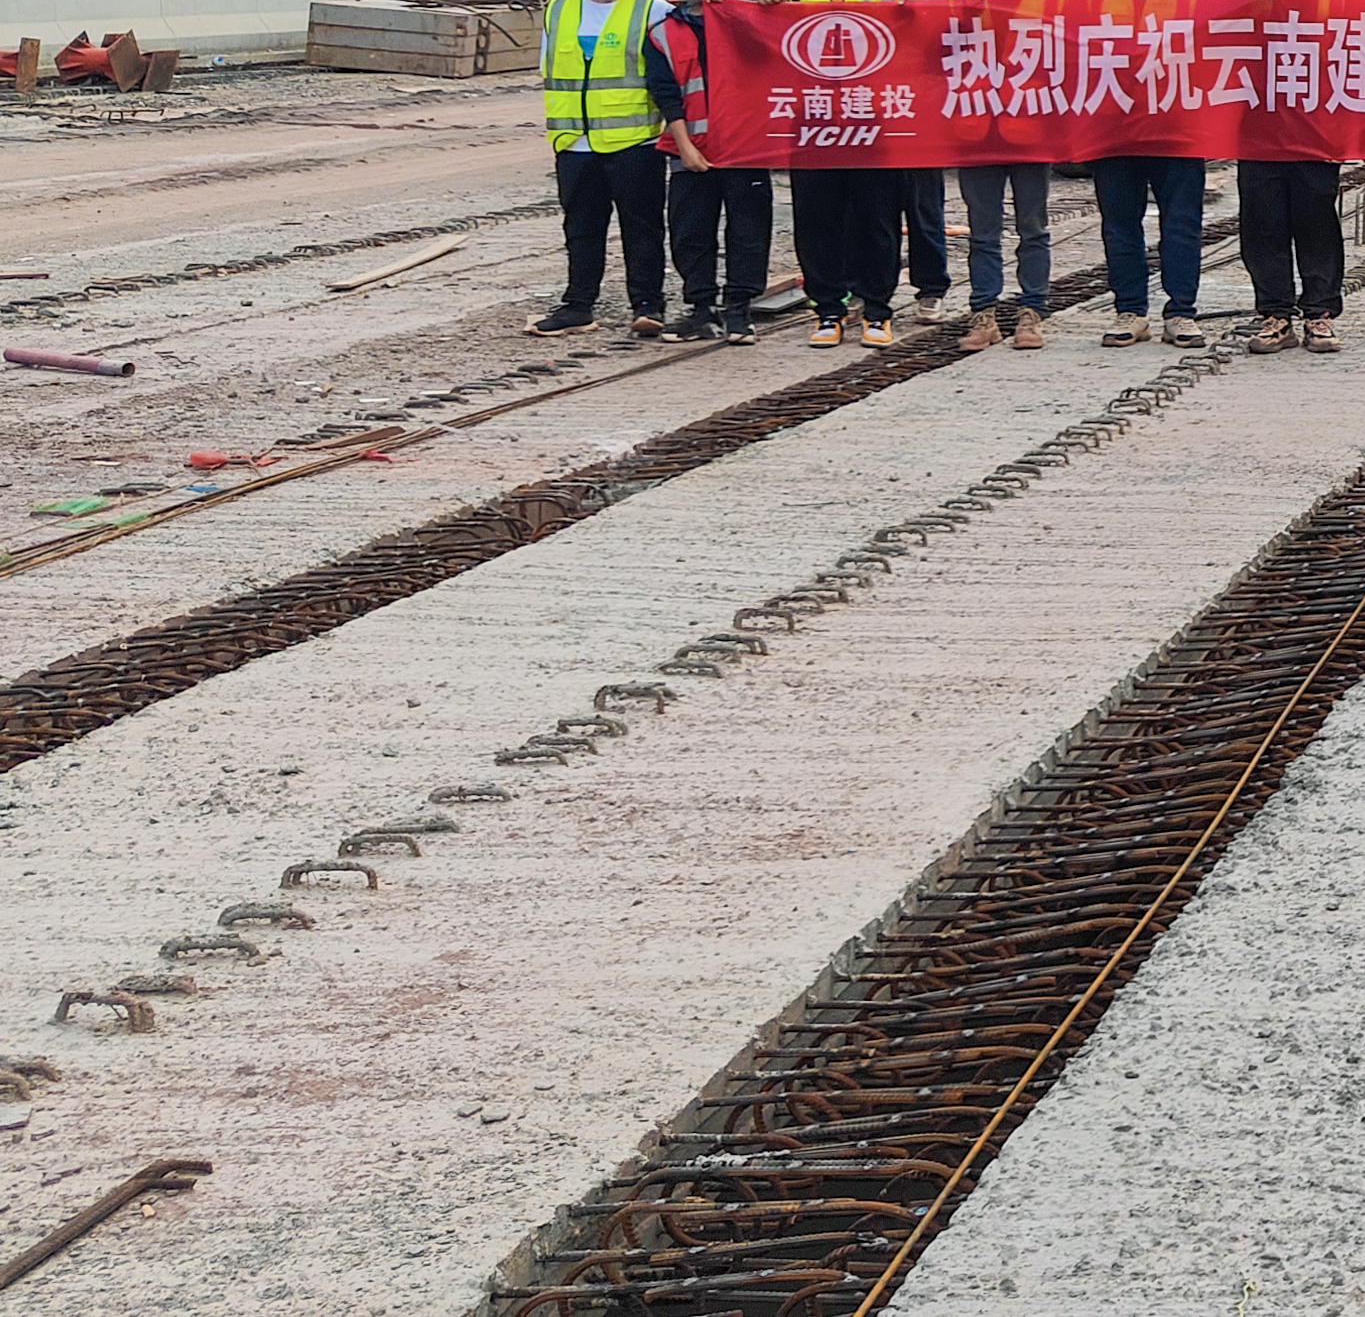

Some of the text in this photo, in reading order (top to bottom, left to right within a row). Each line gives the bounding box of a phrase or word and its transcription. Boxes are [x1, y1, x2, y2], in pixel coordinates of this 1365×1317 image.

[766, 85, 915, 120] 云南建投
[798, 125, 882, 147] YCIH
